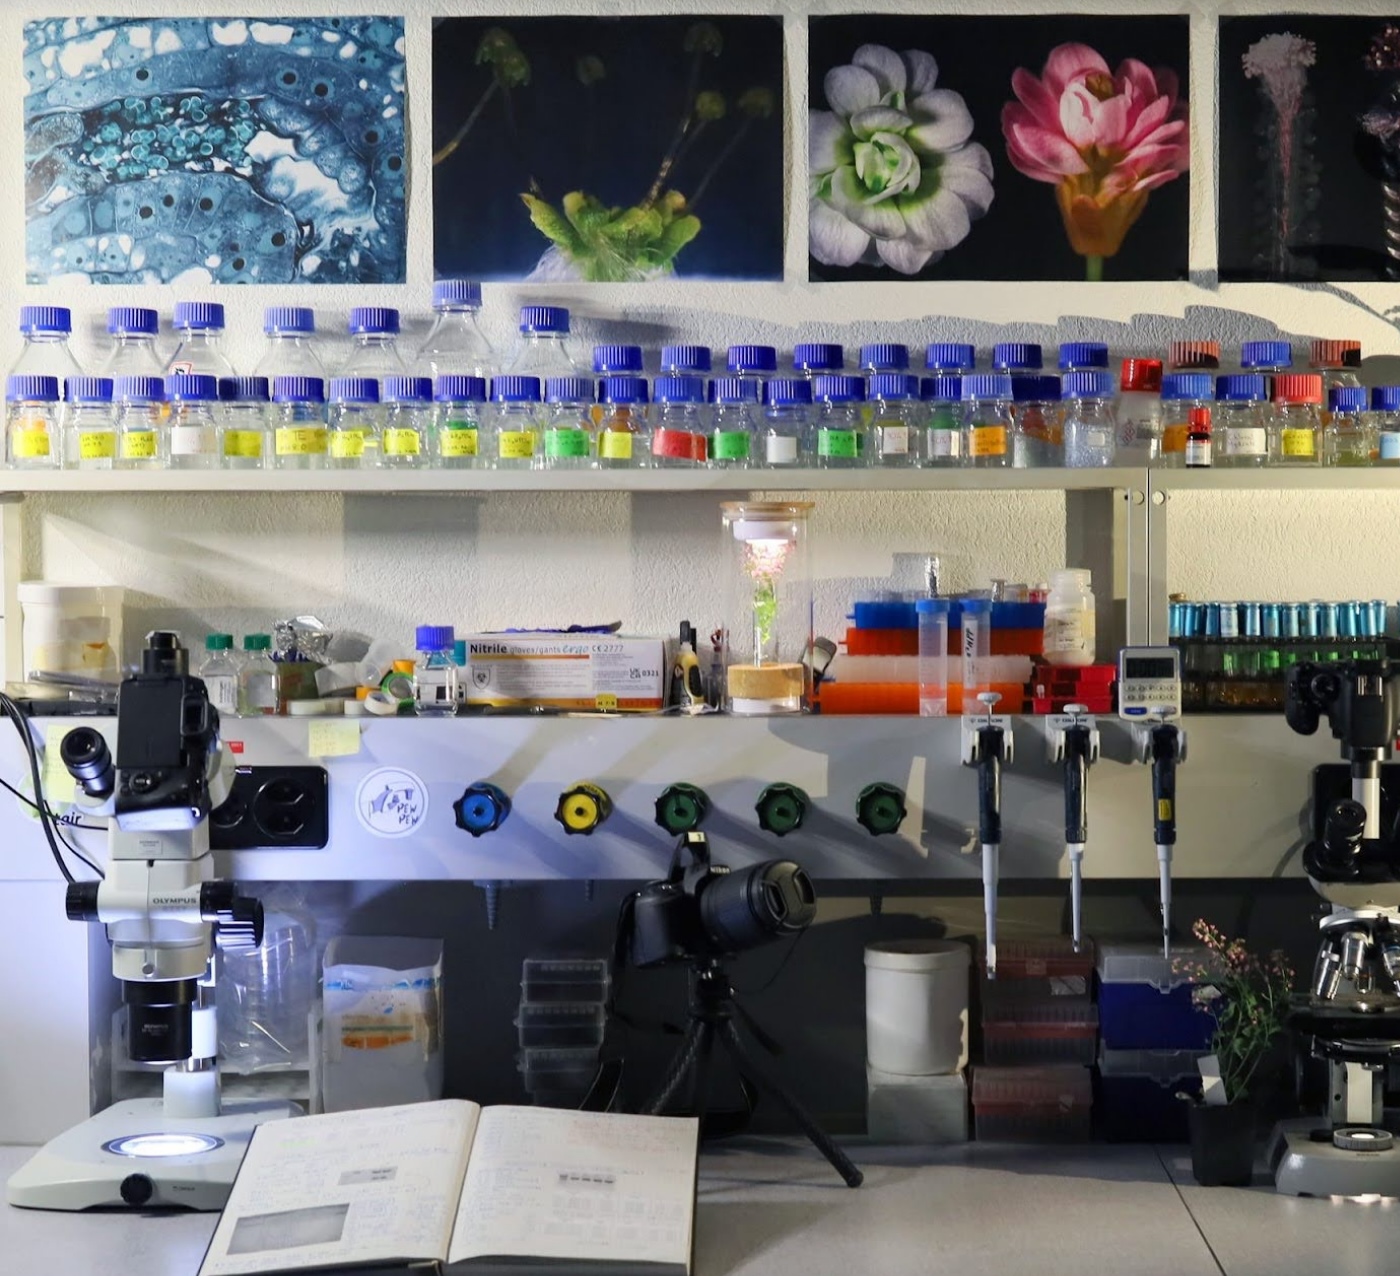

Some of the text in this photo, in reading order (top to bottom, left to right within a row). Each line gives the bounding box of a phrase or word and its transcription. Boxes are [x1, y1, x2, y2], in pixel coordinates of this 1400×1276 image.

[470, 643, 508, 654] Nitrile
[603, 644, 624, 652] 2777
[397, 802, 417, 813] PEW
[399, 814, 419, 826] PEW
[152, 897, 197, 905] OLYMPUS
